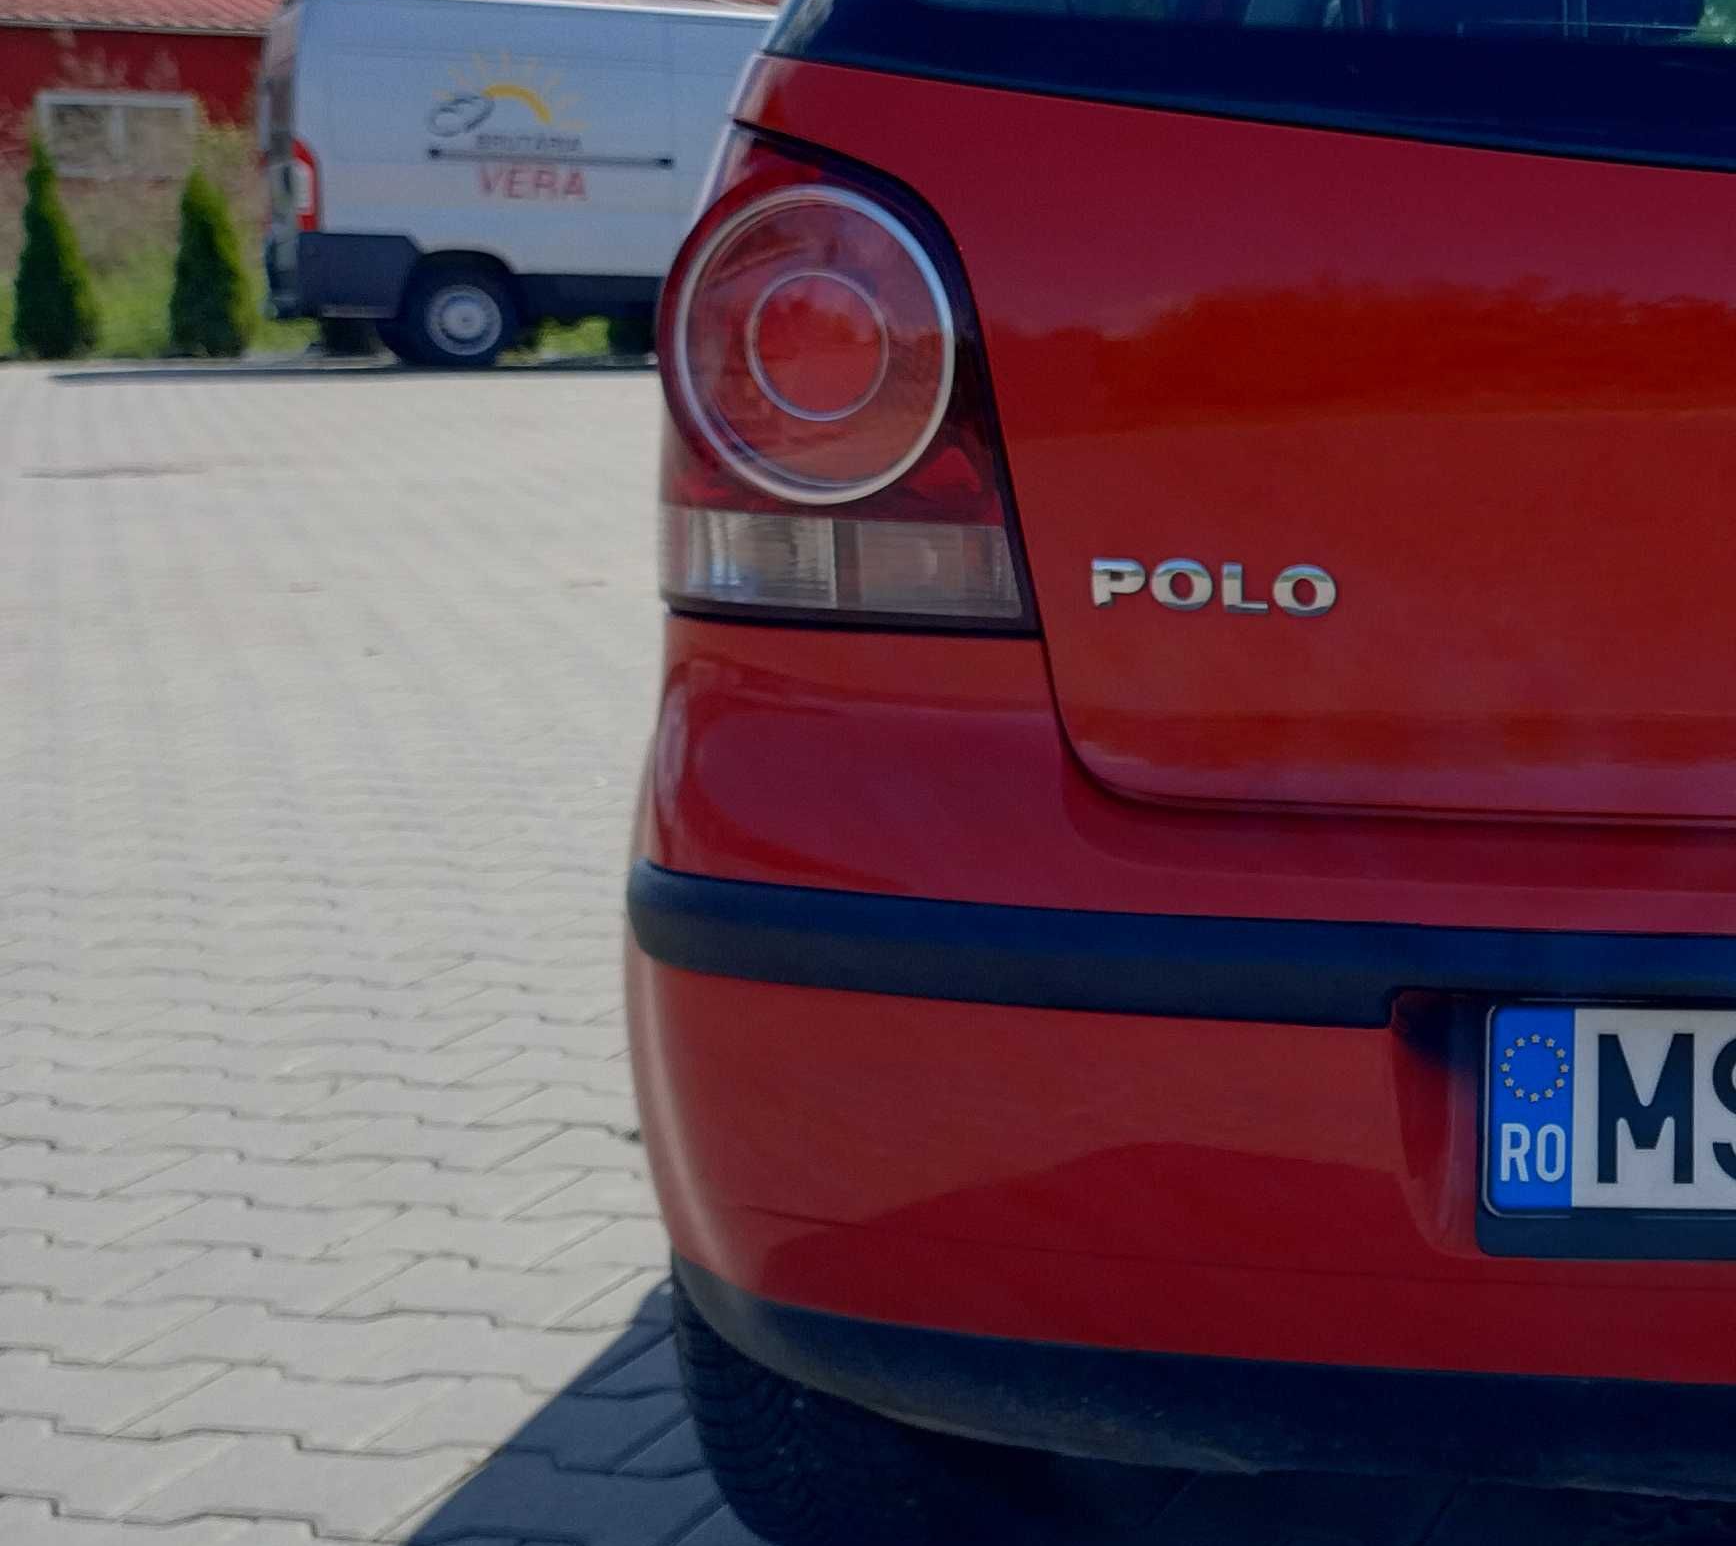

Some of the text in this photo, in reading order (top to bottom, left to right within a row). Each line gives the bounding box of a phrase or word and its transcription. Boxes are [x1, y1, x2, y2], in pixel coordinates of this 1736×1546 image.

[478, 164, 586, 199] VERA
[1091, 557, 1337, 617] POLO
[1500, 1122, 1567, 1184] RO
